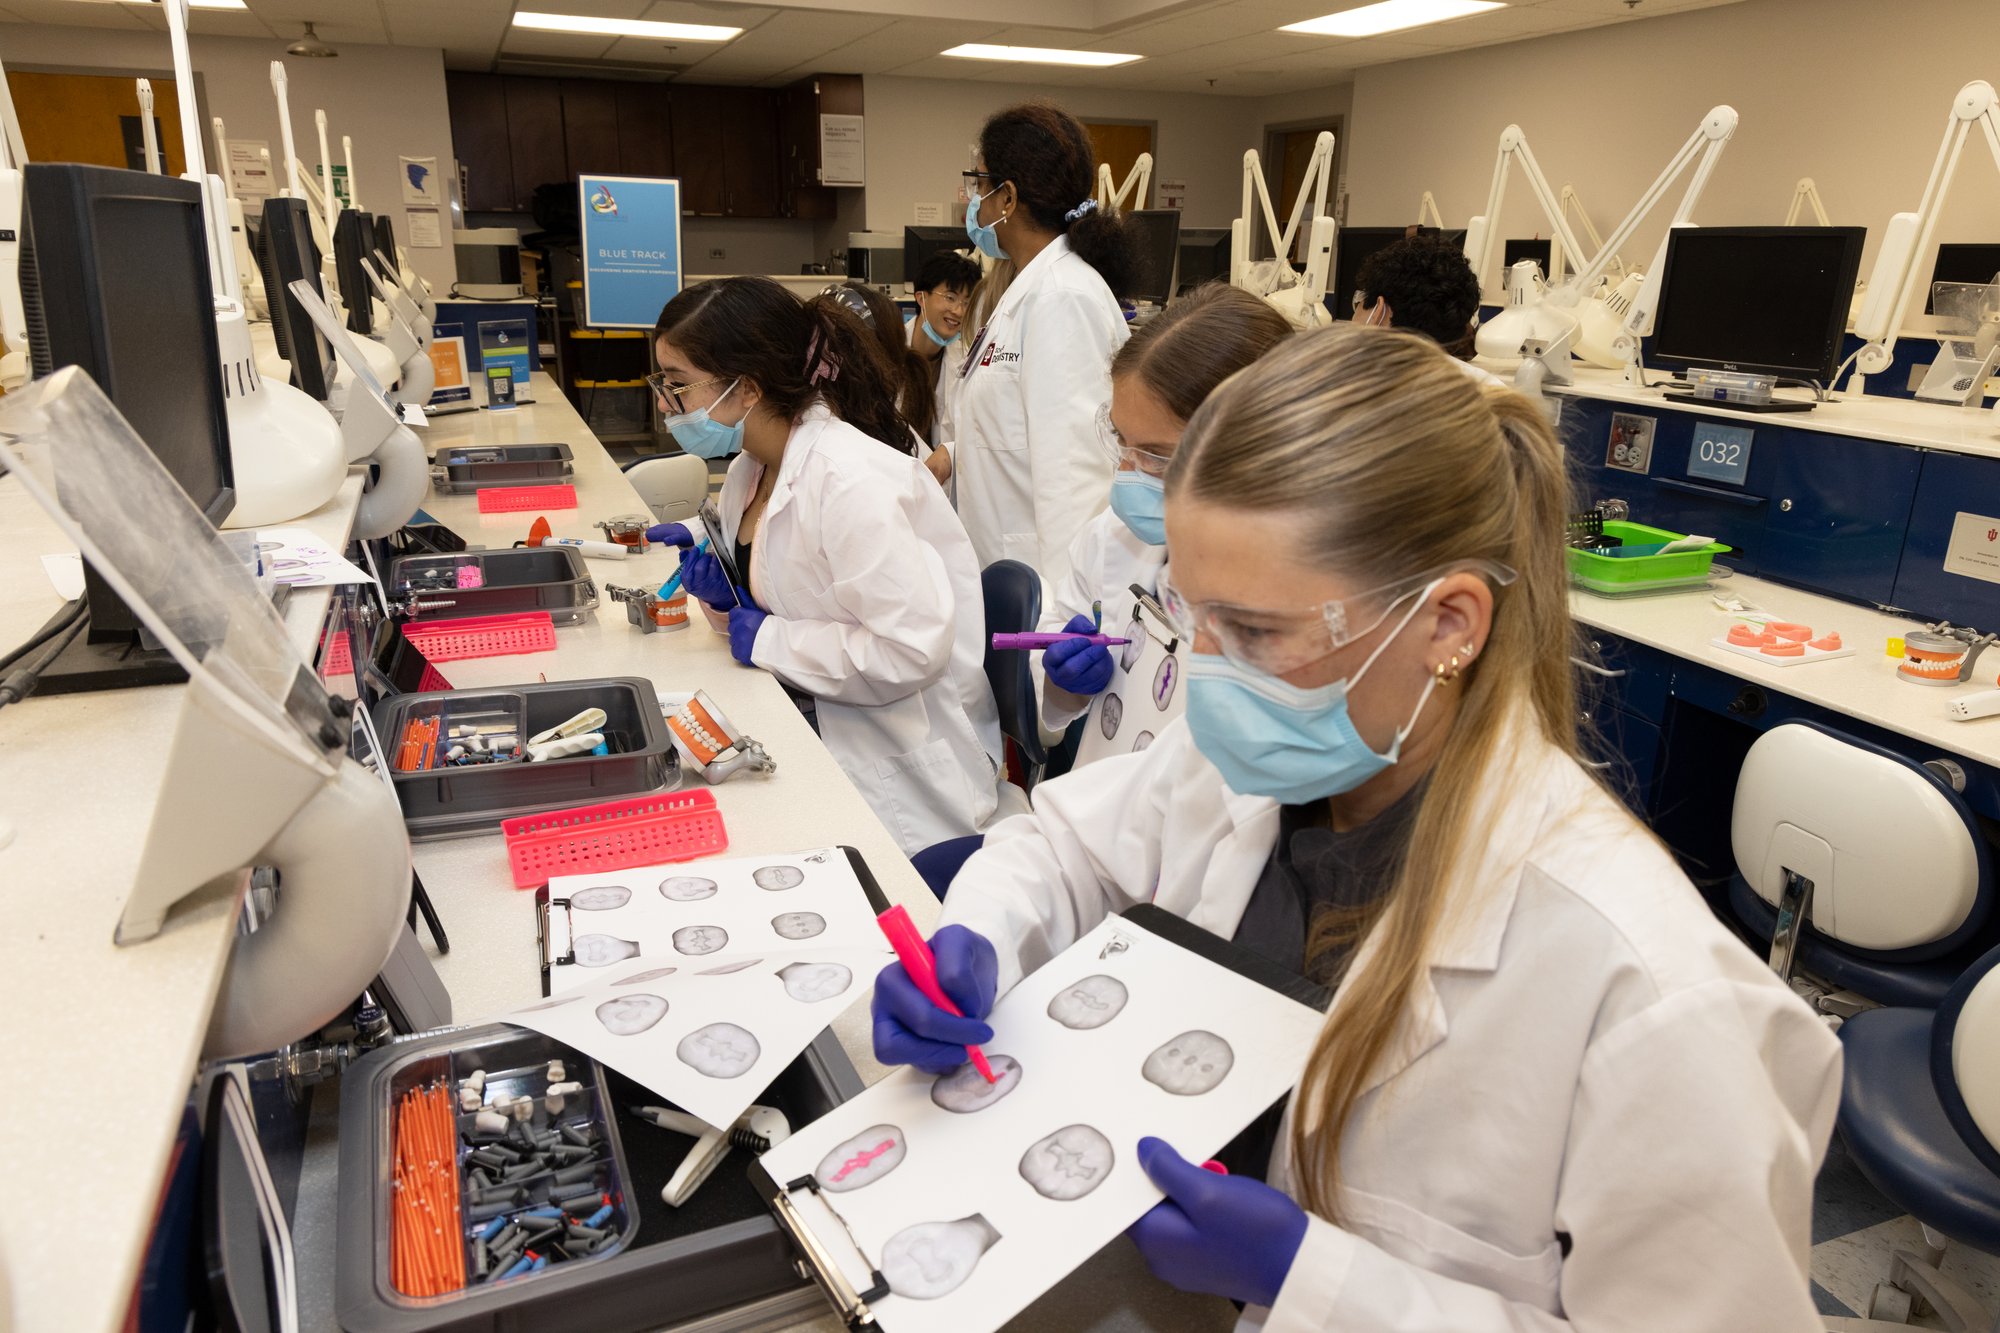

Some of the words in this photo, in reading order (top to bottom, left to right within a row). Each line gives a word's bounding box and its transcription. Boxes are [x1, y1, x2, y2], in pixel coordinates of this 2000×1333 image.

[599, 249, 627, 258] BLUE
[631, 250, 666, 259] TRACK
[1700, 440, 1741, 466] 032
